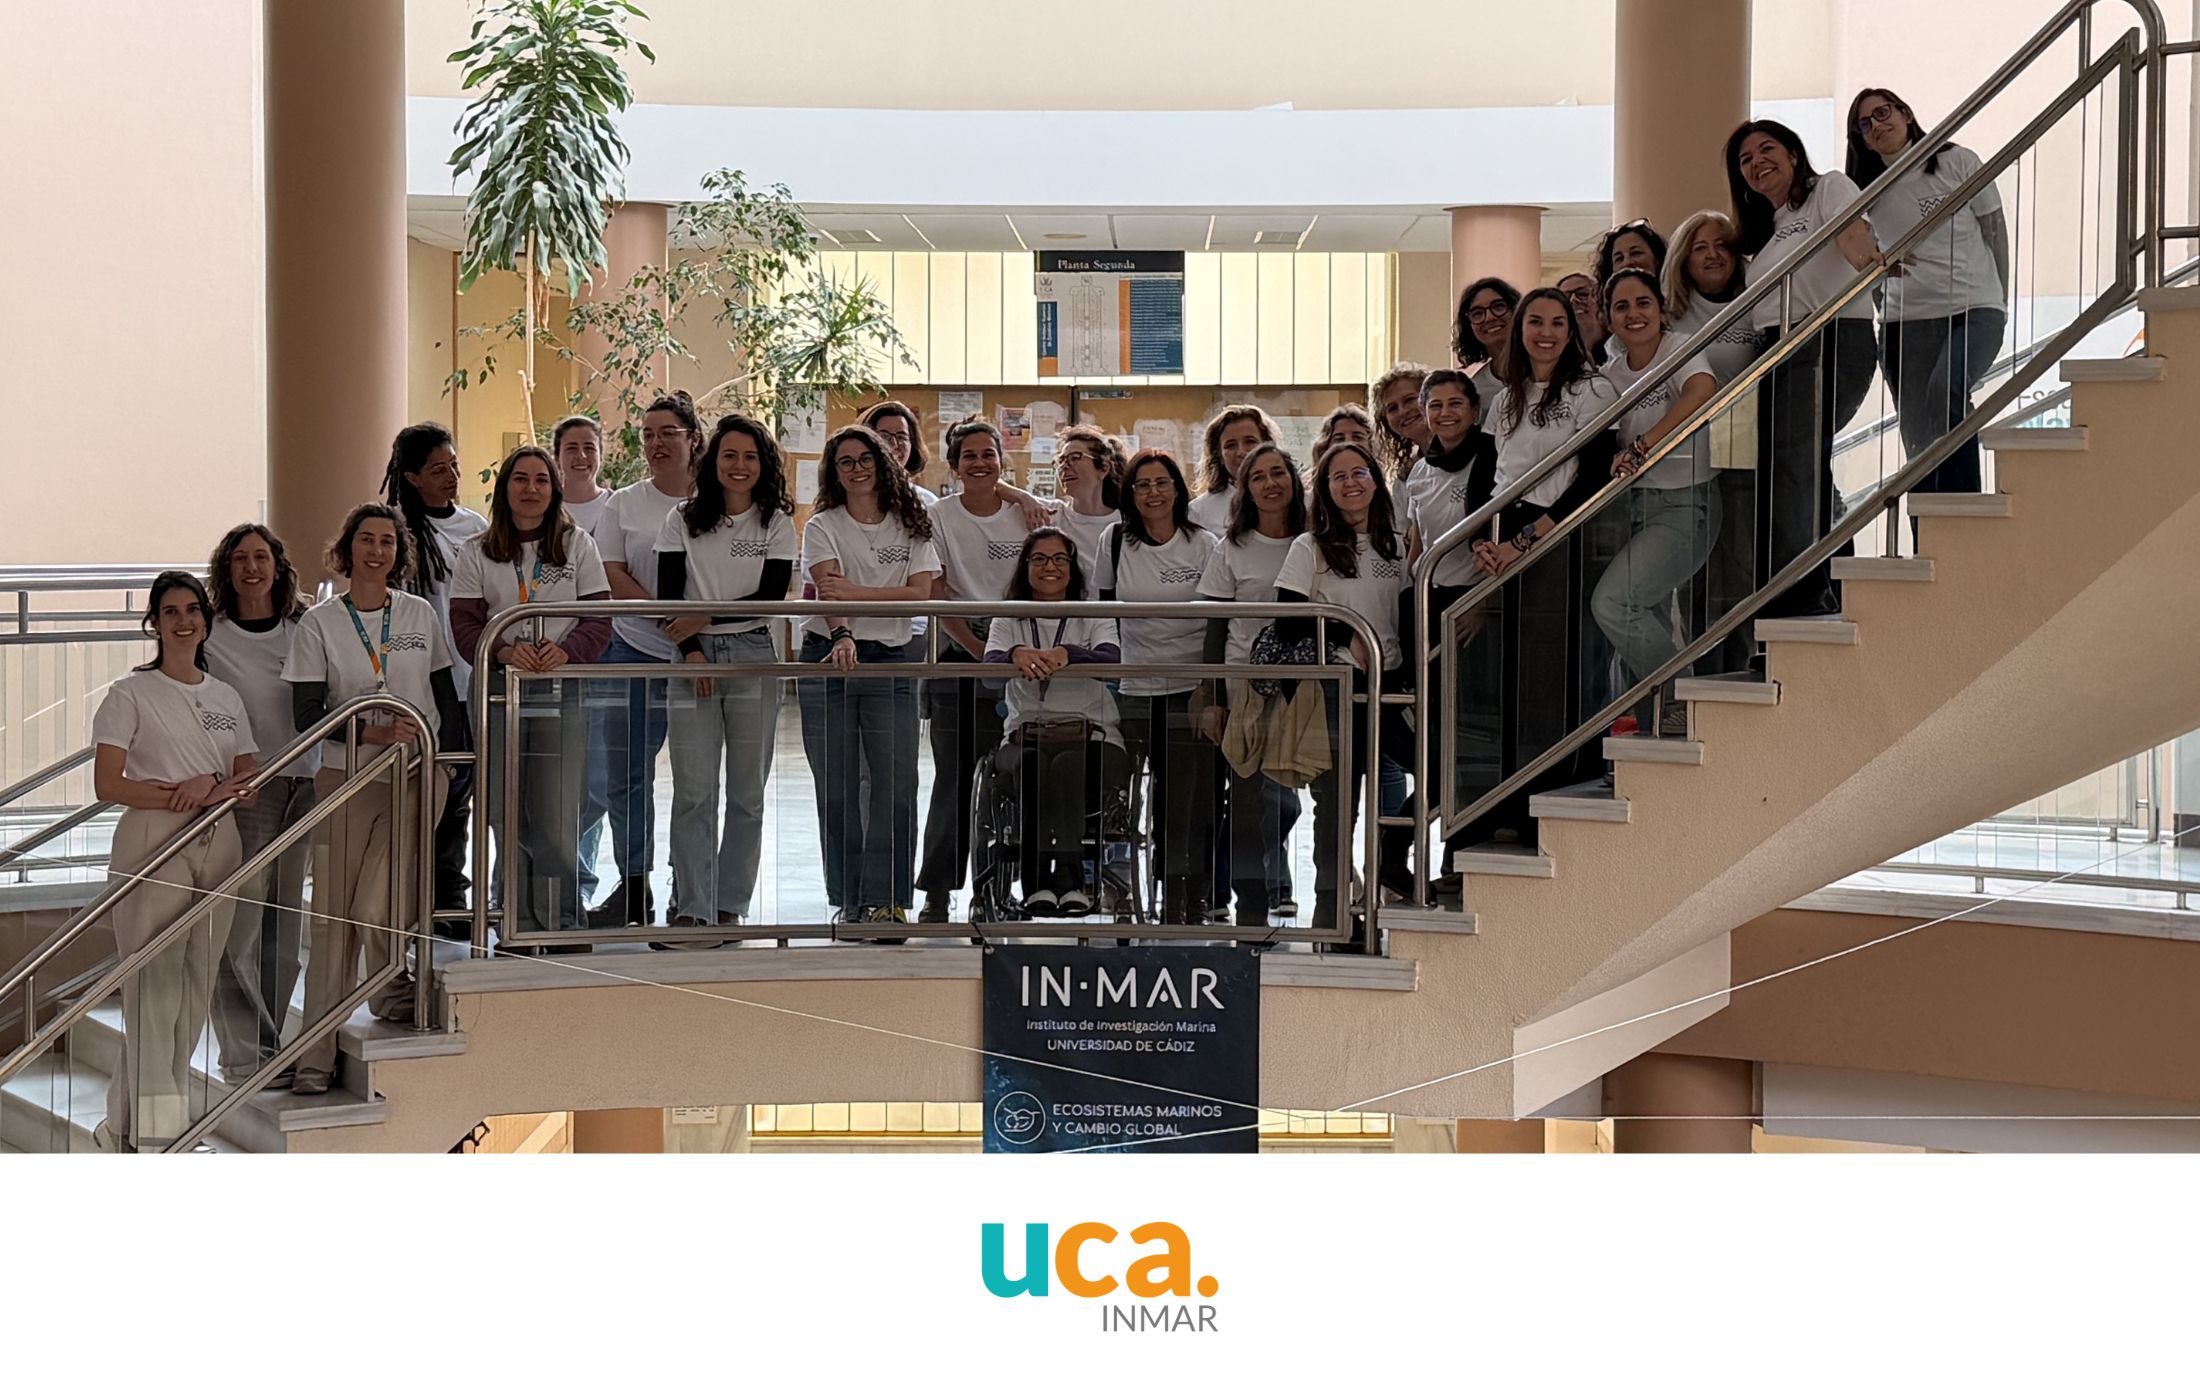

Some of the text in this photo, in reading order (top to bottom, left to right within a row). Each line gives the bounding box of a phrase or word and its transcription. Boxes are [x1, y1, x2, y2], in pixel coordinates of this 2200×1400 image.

[1057, 259, 1136, 271] Planta Segunda
[1026, 1019, 1217, 1034] Instituto de Investigación Marina
[1047, 1038, 1196, 1053] UNIVERSIDAD DE CÁDIZ
[1052, 1103, 1223, 1118] ECOSISTEMAS MARINOS
[1052, 1121, 1182, 1136] Y CAMBIO GLOBAL
